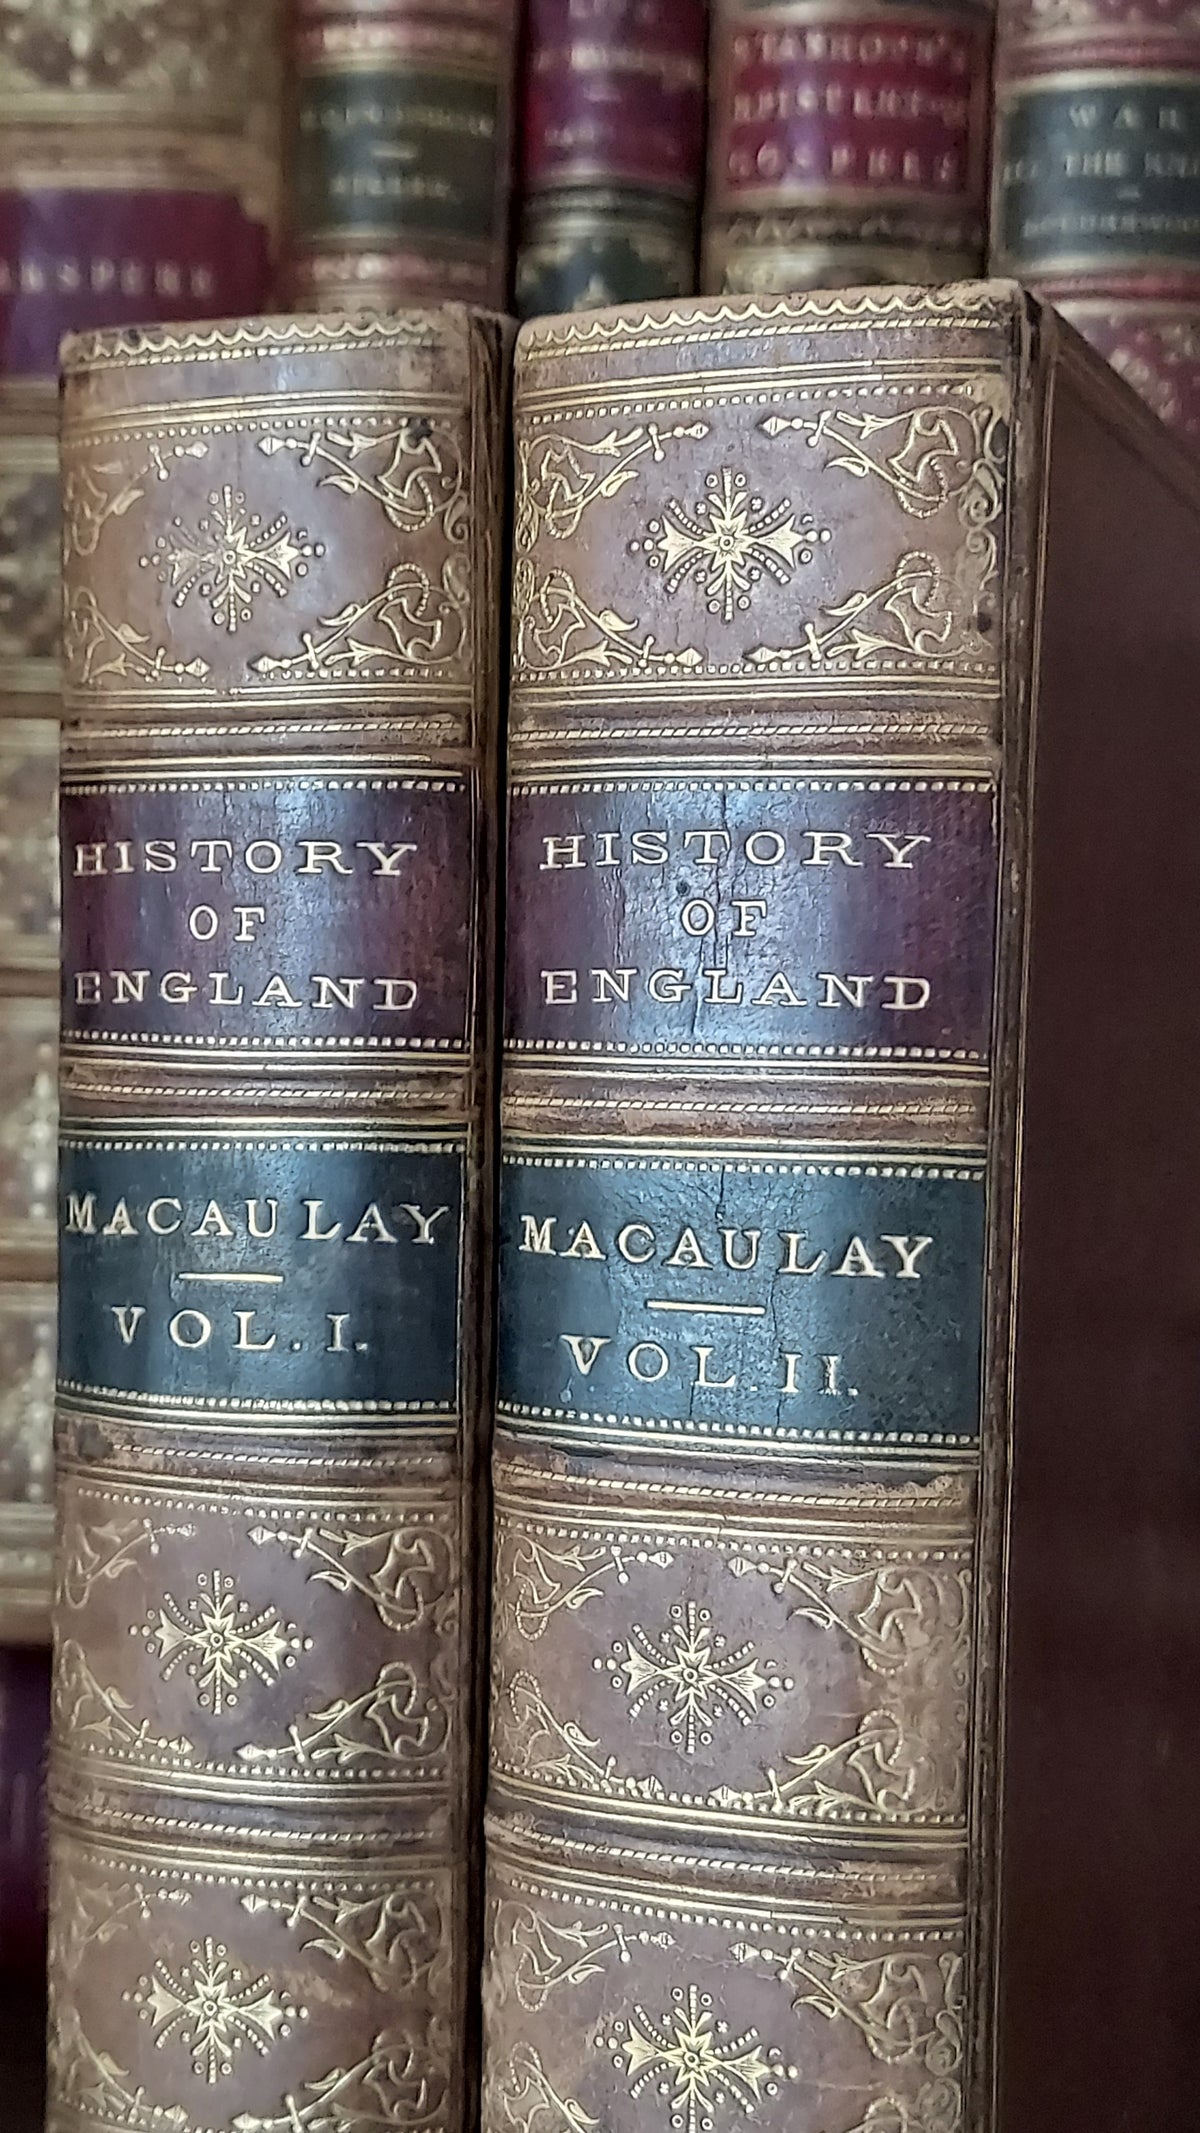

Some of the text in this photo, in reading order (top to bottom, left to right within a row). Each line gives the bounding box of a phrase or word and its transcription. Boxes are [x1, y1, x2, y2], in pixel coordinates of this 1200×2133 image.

[72, 839, 418, 877] HISTORY
[538, 830, 932, 870] HISTORY
[188, 904, 267, 942] OF
[680, 899, 768, 937] OF
[74, 970, 418, 1011] ENGLAND
[539, 968, 932, 1011] ENGLAND
[64, 1191, 451, 1245] MACAULAY
[518, 1215, 934, 1279] MACAULAY
